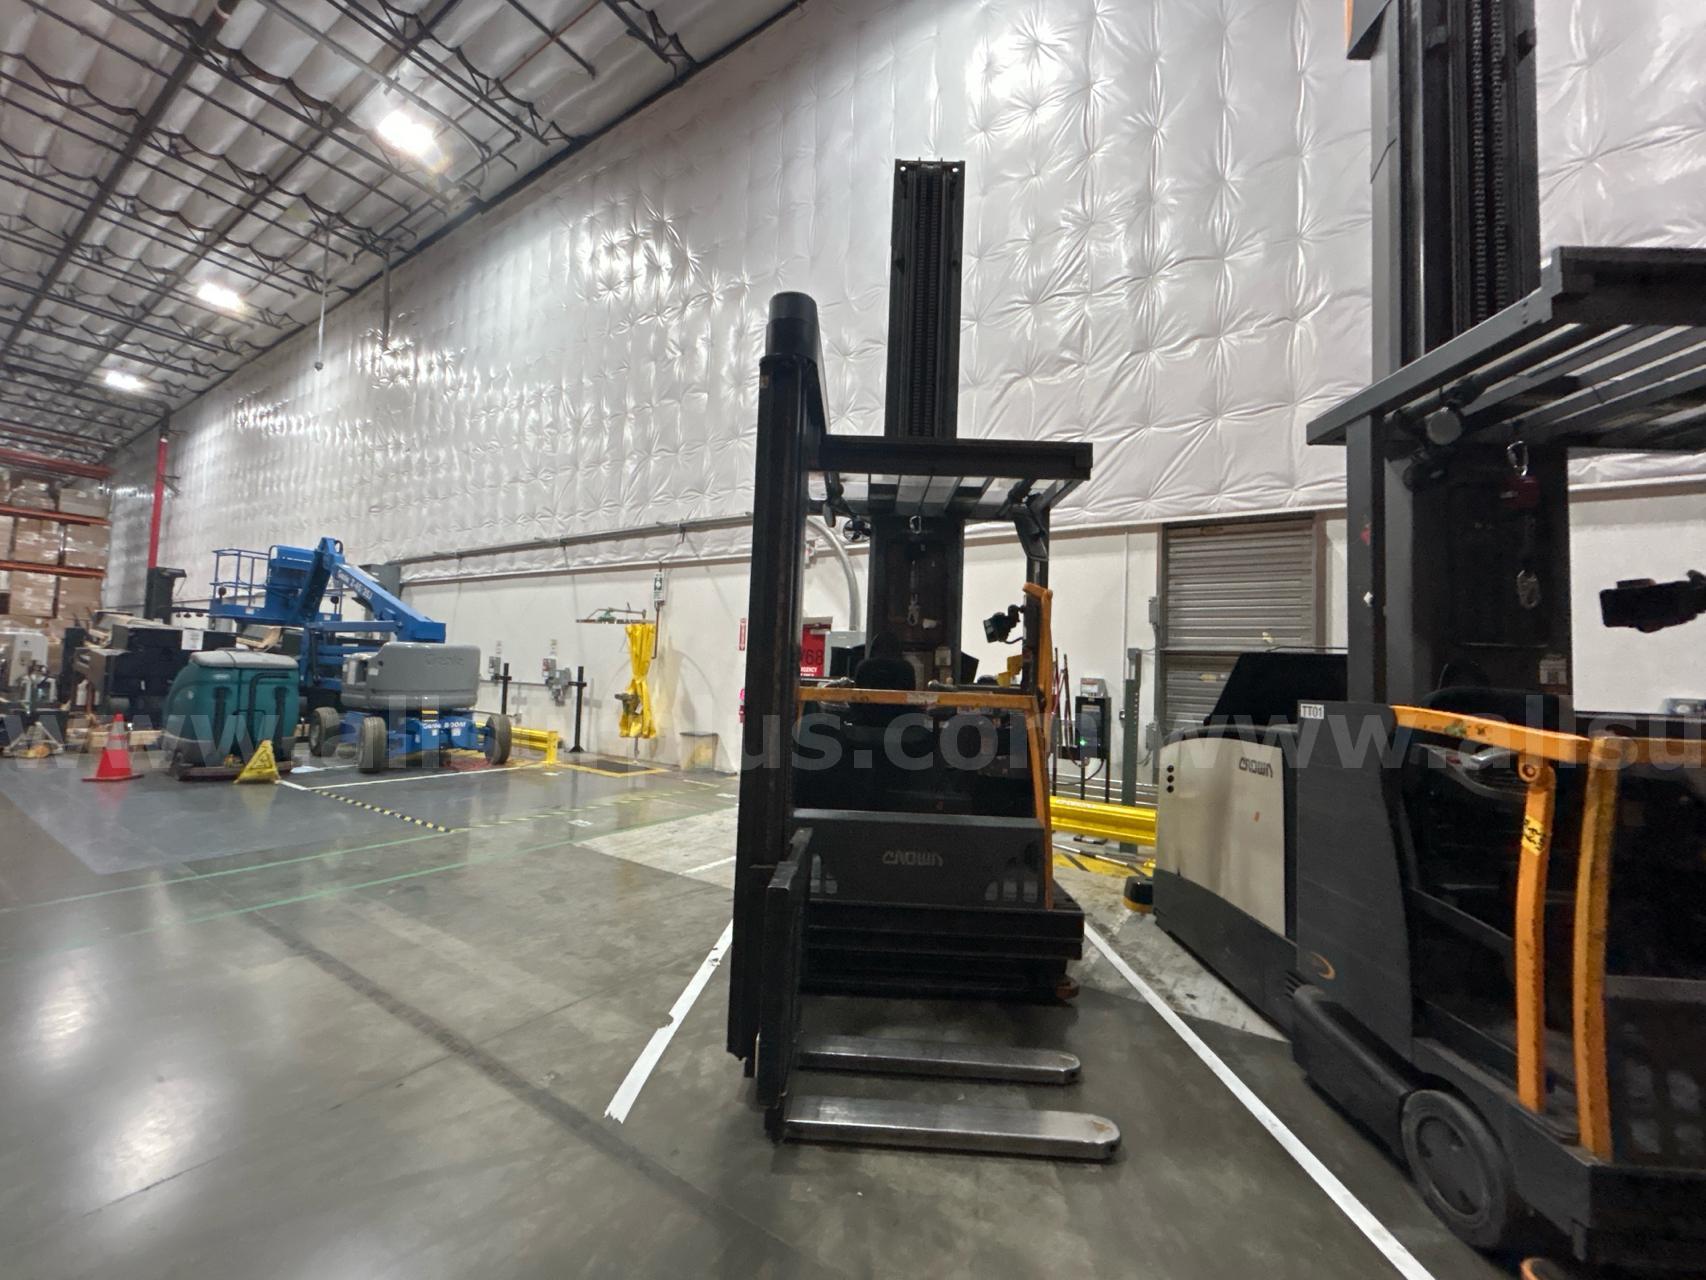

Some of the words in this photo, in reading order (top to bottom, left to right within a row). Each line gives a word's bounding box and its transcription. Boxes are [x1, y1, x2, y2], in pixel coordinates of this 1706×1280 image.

[1302, 705, 1323, 718] TT01
[1239, 757, 1273, 779] CROWN
[882, 850, 943, 867] CROWN
